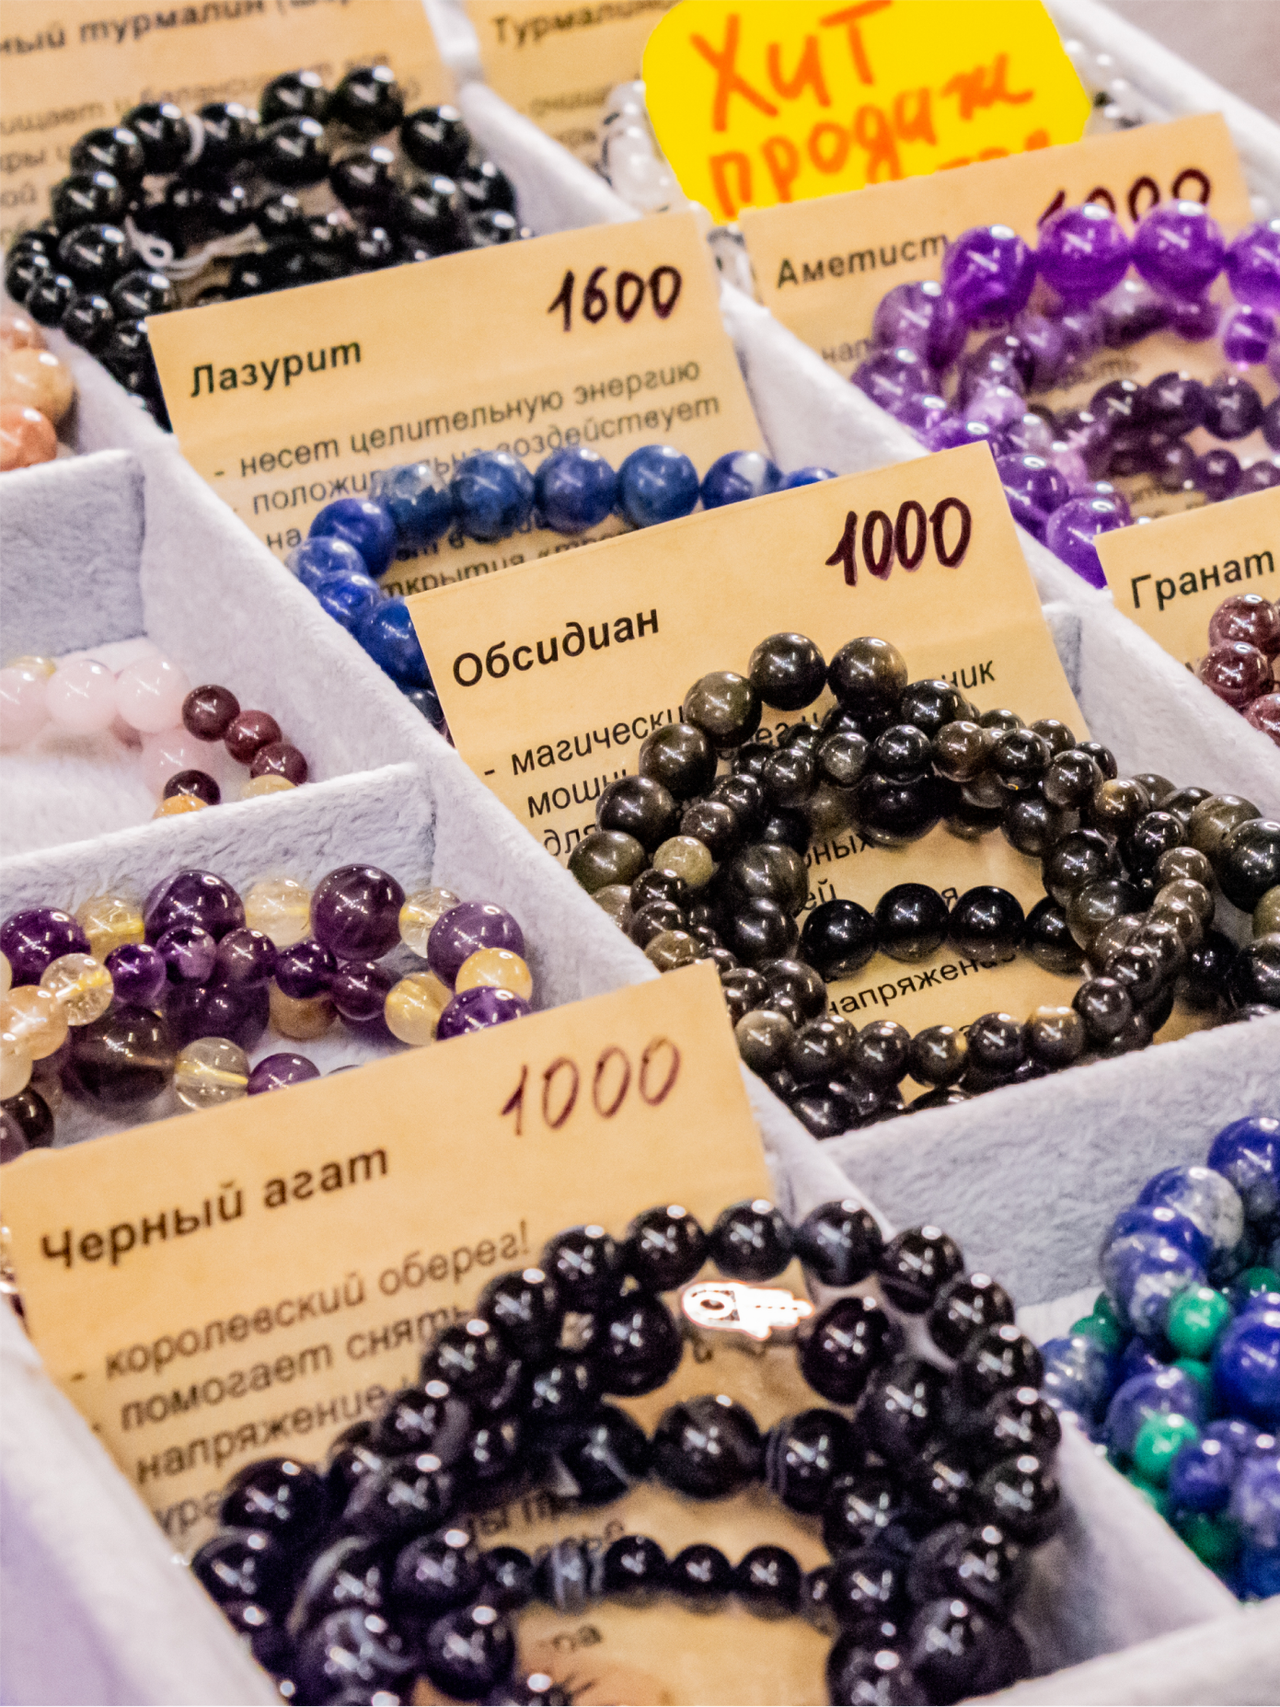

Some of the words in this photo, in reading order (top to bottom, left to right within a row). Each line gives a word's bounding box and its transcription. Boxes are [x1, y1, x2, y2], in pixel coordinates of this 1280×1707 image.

[547, 264, 683, 332] 1600
[189, 340, 363, 398] Лазурит
[240, 438, 340, 479] несет
[350, 388, 564, 455] целительную
[574, 359, 701, 406] энергию
[824, 497, 973, 588] 1000
[1130, 549, 1277, 612] Гранат
[452, 608, 660, 688] Обсидиан
[500, 1035, 682, 1137] 1000
[40, 1180, 247, 1271] Черный
[262, 1145, 391, 1209] агат
[105, 1270, 367, 1381] королевский
[378, 1218, 531, 1297] оберег!
[119, 1339, 334, 1433] помогает
[135, 1377, 387, 1485] напряжение
